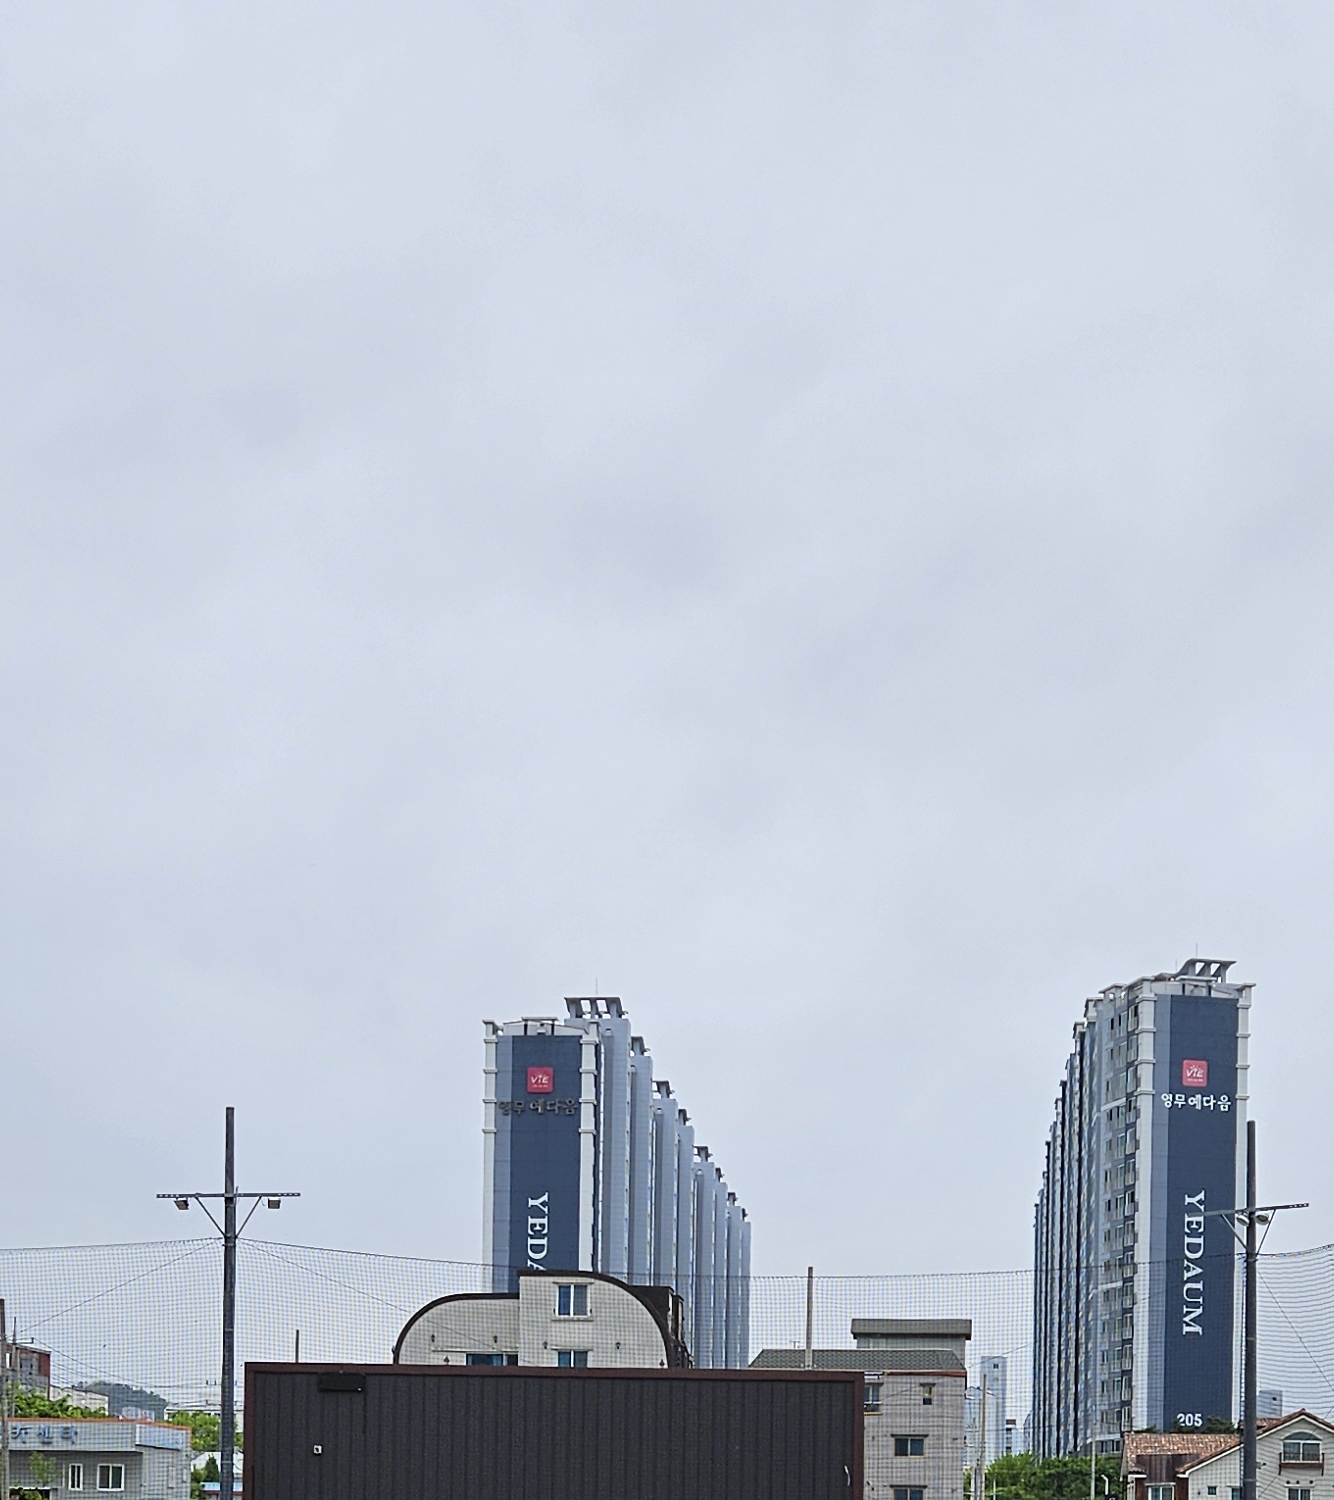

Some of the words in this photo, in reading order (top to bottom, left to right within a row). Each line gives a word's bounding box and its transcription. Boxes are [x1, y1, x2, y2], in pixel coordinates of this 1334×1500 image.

[1161, 1093, 1232, 1112] 영무예다음
[1182, 1190, 1206, 1337] YEDAUM
[1177, 1413, 1202, 1427] 205
